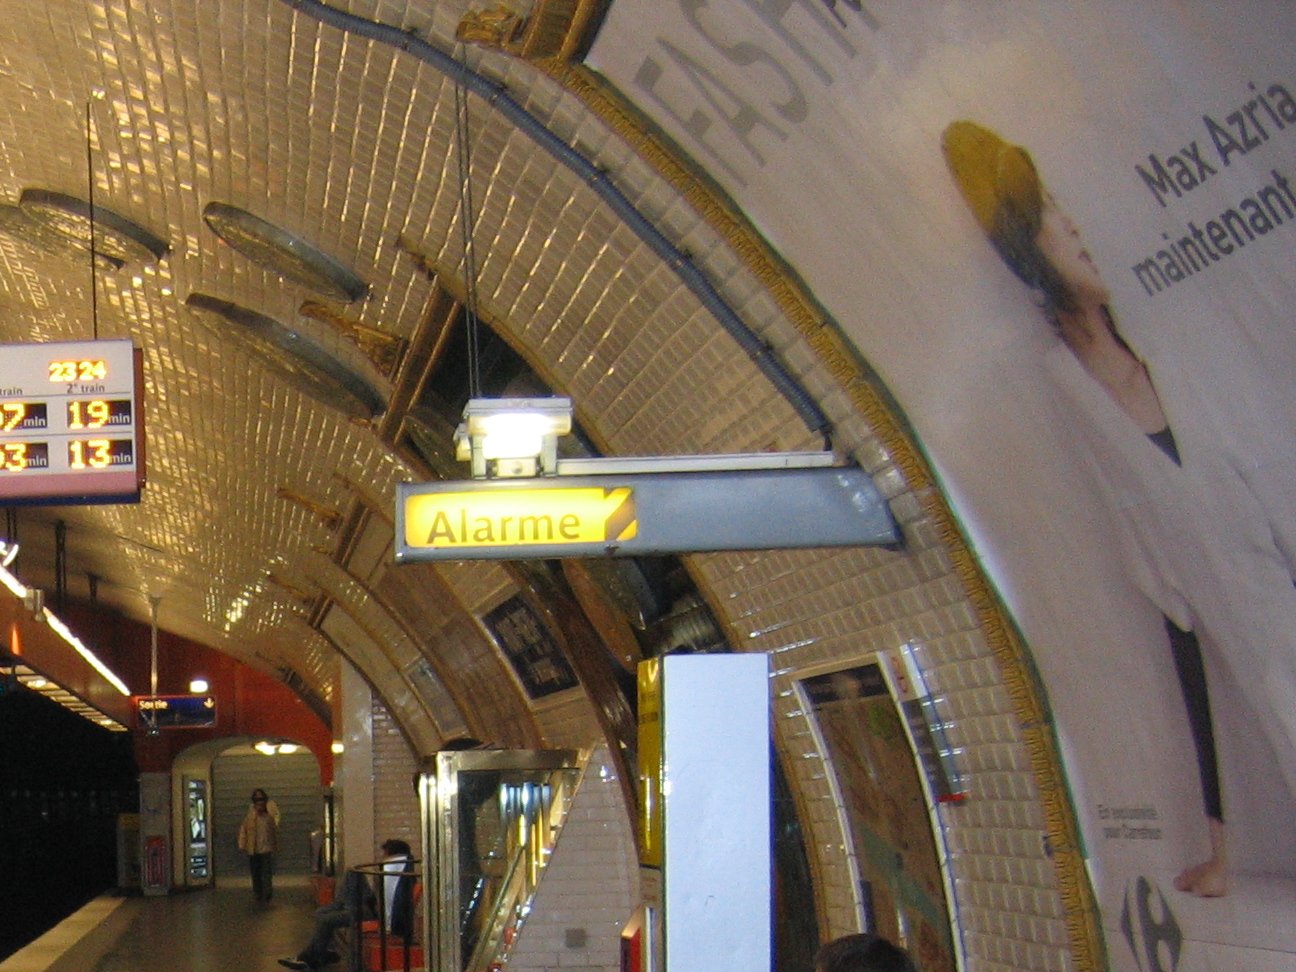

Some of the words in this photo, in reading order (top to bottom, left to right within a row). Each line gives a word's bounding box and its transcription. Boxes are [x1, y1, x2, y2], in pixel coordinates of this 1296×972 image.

[1134, 140, 1218, 208] Max
[1202, 81, 1296, 167] Azria
[1131, 169, 1296, 297] maintenant
[0, 387, 23, 396] train
[81, 383, 106, 393] train
[24, 416, 46, 427] min
[69, 400, 109, 430] 19
[108, 413, 130, 424] min
[26, 455, 47, 467] min
[70, 439, 110, 470] 13
[110, 452, 132, 464] min
[426, 508, 581, 545] Alarme
